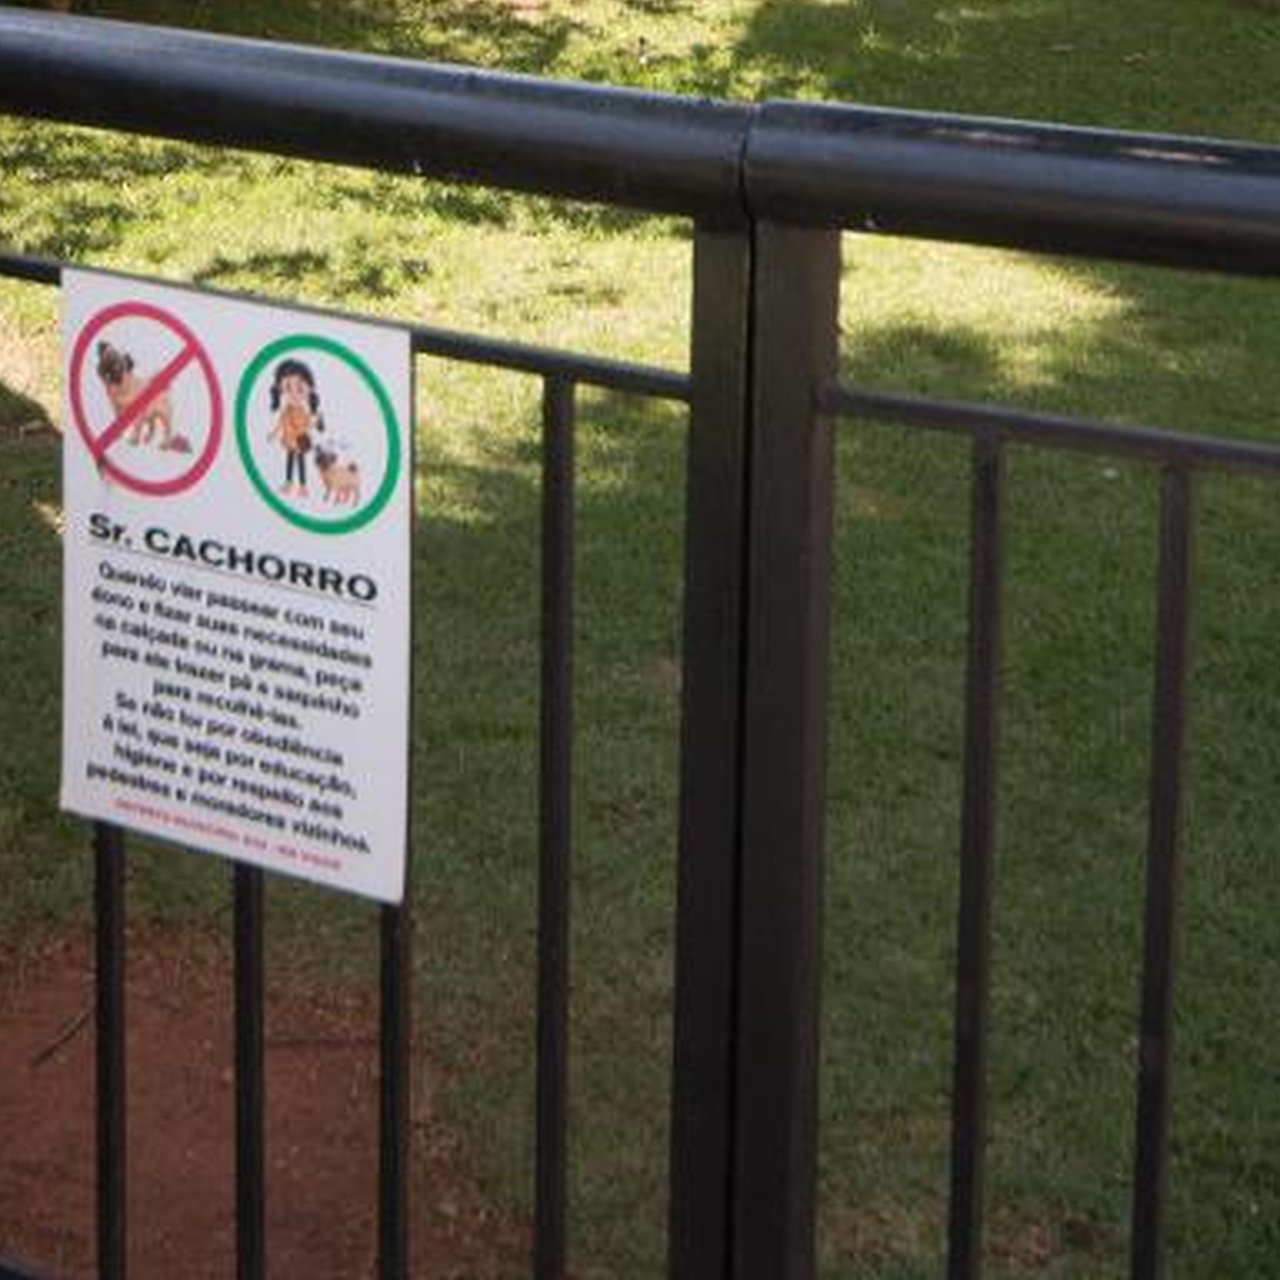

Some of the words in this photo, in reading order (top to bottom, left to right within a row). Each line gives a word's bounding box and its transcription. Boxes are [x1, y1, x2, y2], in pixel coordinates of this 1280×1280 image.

[89, 512, 131, 546] Sr.
[145, 525, 377, 603] CACHORRO
[284, 607, 323, 631] com
[244, 623, 372, 669] necessidades
[225, 749, 255, 771] por
